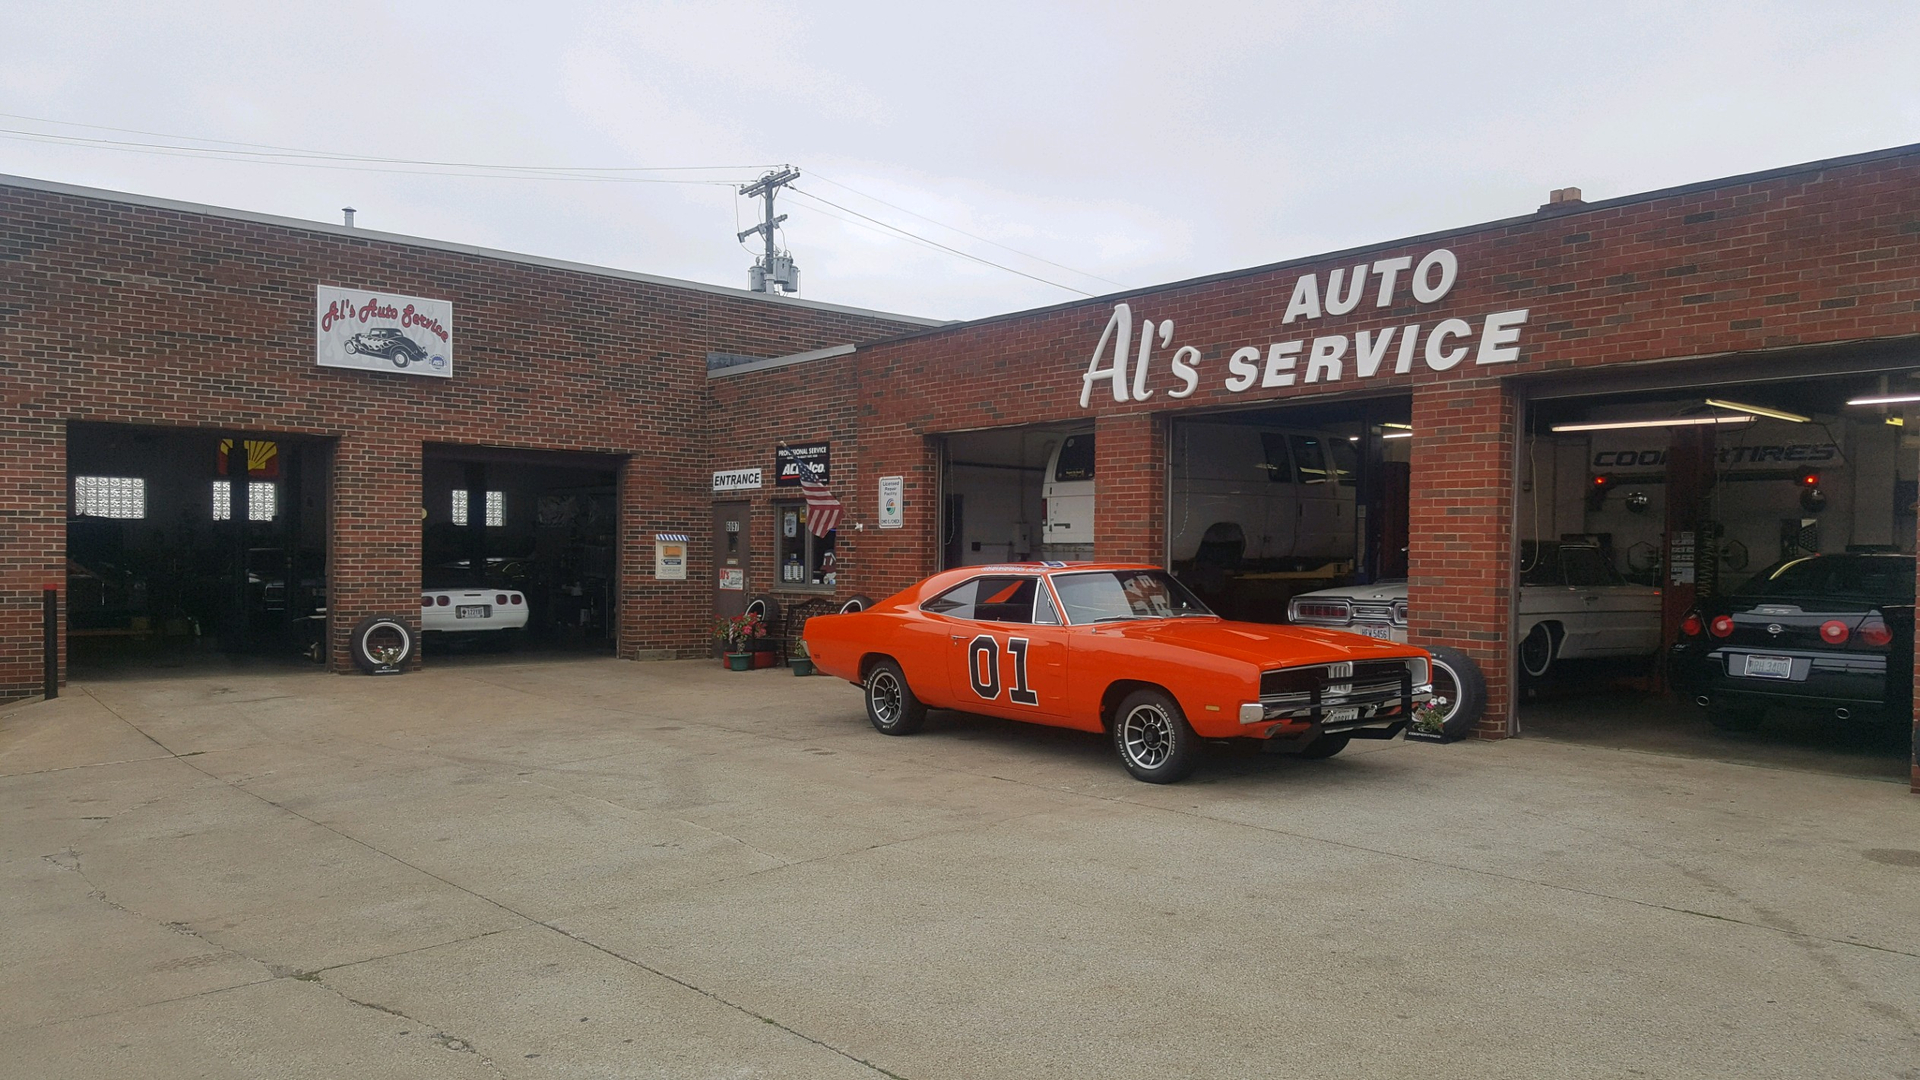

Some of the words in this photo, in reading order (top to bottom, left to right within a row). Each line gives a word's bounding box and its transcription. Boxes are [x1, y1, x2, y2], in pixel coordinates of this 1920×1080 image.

[1281, 248, 1459, 325] AUTO
[322, 298, 356, 332] Al's
[358, 297, 399, 323] Auto
[401, 303, 449, 343] Service
[1078, 302, 1202, 409] Al's
[1224, 309, 1530, 393] SERVICE
[714, 472, 760, 487] ENTRANCE
[809, 446, 827, 454] SERVICE
[968, 634, 1039, 707] 01
